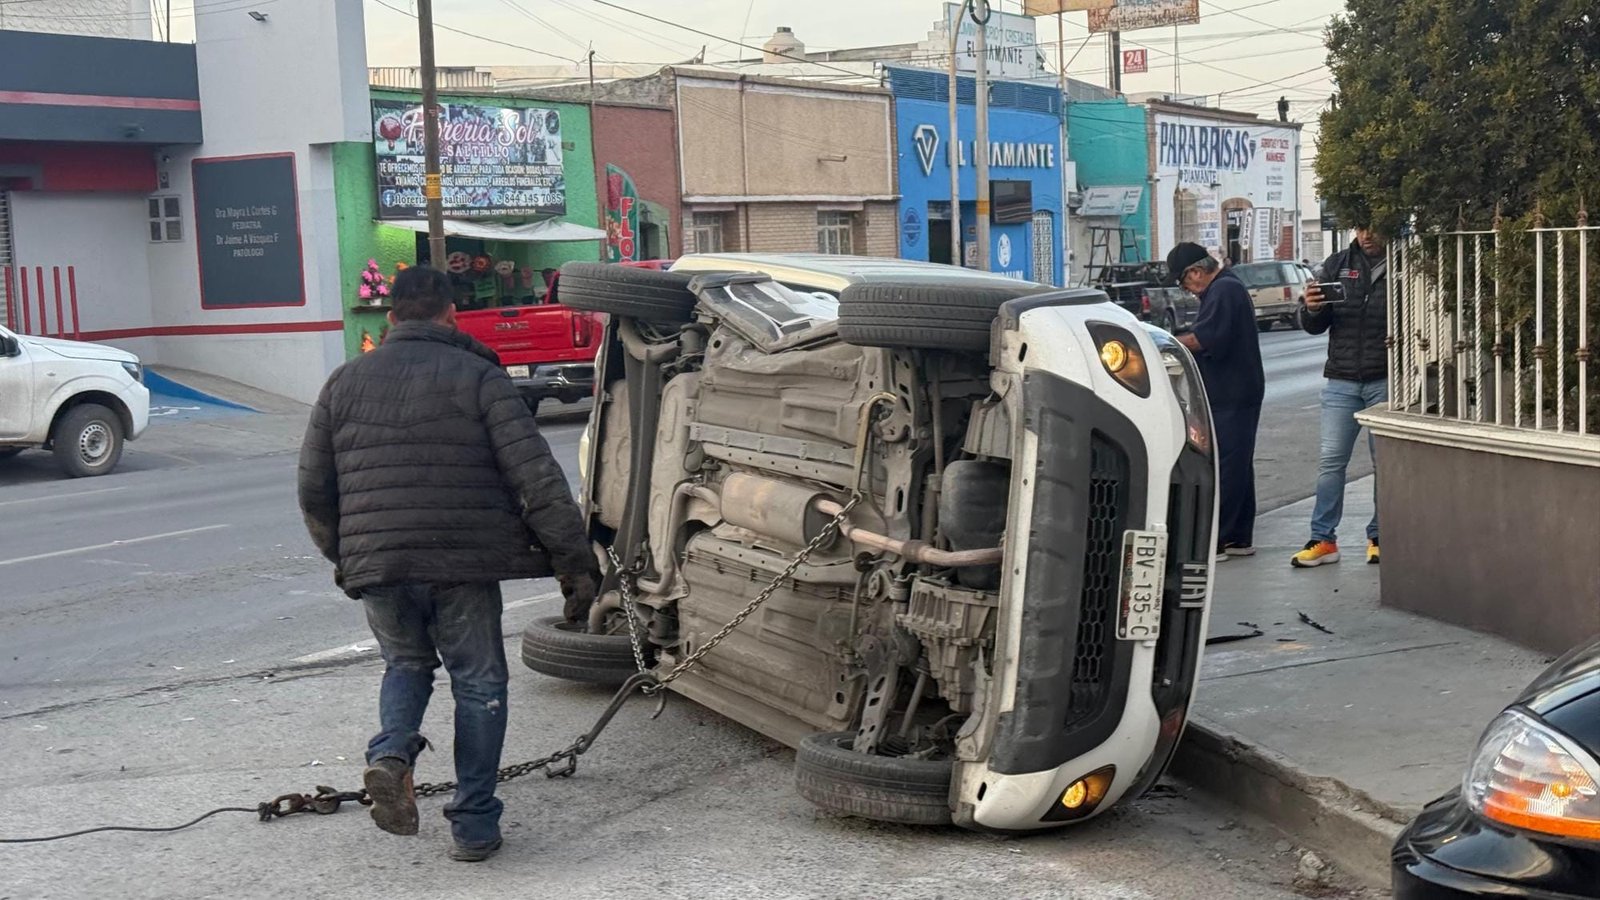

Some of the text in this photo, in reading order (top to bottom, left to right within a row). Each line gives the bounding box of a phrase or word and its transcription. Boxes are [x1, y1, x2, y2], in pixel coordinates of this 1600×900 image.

[967, 40, 1022, 64] EL IAMANTE
[1126, 52, 1142, 66] 24
[498, 112, 533, 146] Sol
[447, 145, 509, 157] SALTILLO
[973, 140, 1054, 168] IAMANTE
[1160, 122, 1249, 170] PARABRISAS
[380, 163, 387, 172] TE
[387, 163, 419, 173] OFRECEMOS
[453, 164, 479, 174] ARREGLOS
[444, 194, 472, 204] saltillo
[505, 193, 561, 204] 844 145 7085
[1130, 535, 1157, 636] FBV-135-C
[1180, 563, 1208, 609] FIAT
